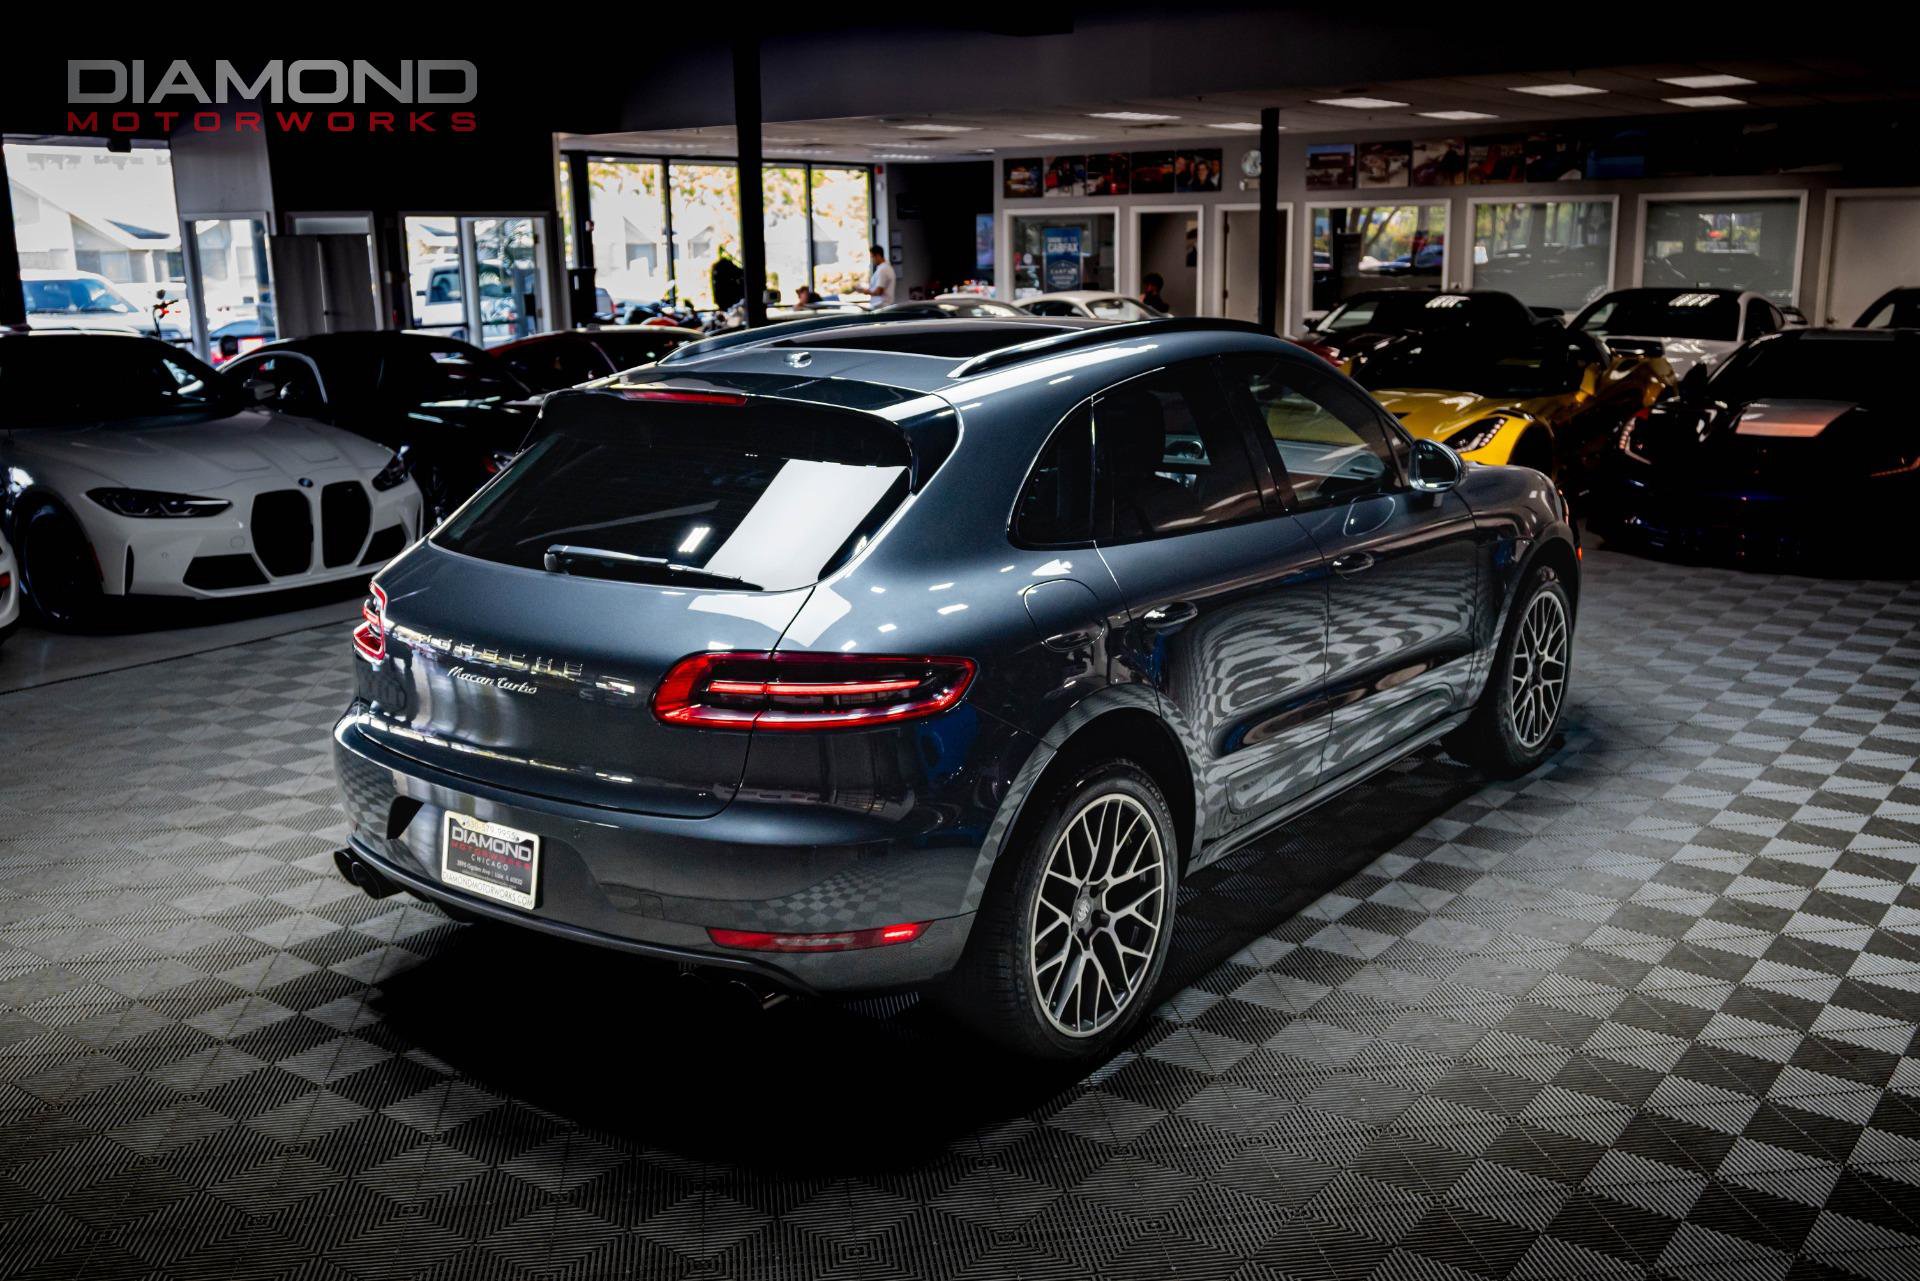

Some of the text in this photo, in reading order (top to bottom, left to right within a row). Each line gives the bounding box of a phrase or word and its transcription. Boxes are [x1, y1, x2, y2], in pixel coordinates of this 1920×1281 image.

[447, 665, 495, 687] Macan
[452, 825, 532, 862] DIAMOND
[471, 853, 509, 871] CHICAGO
